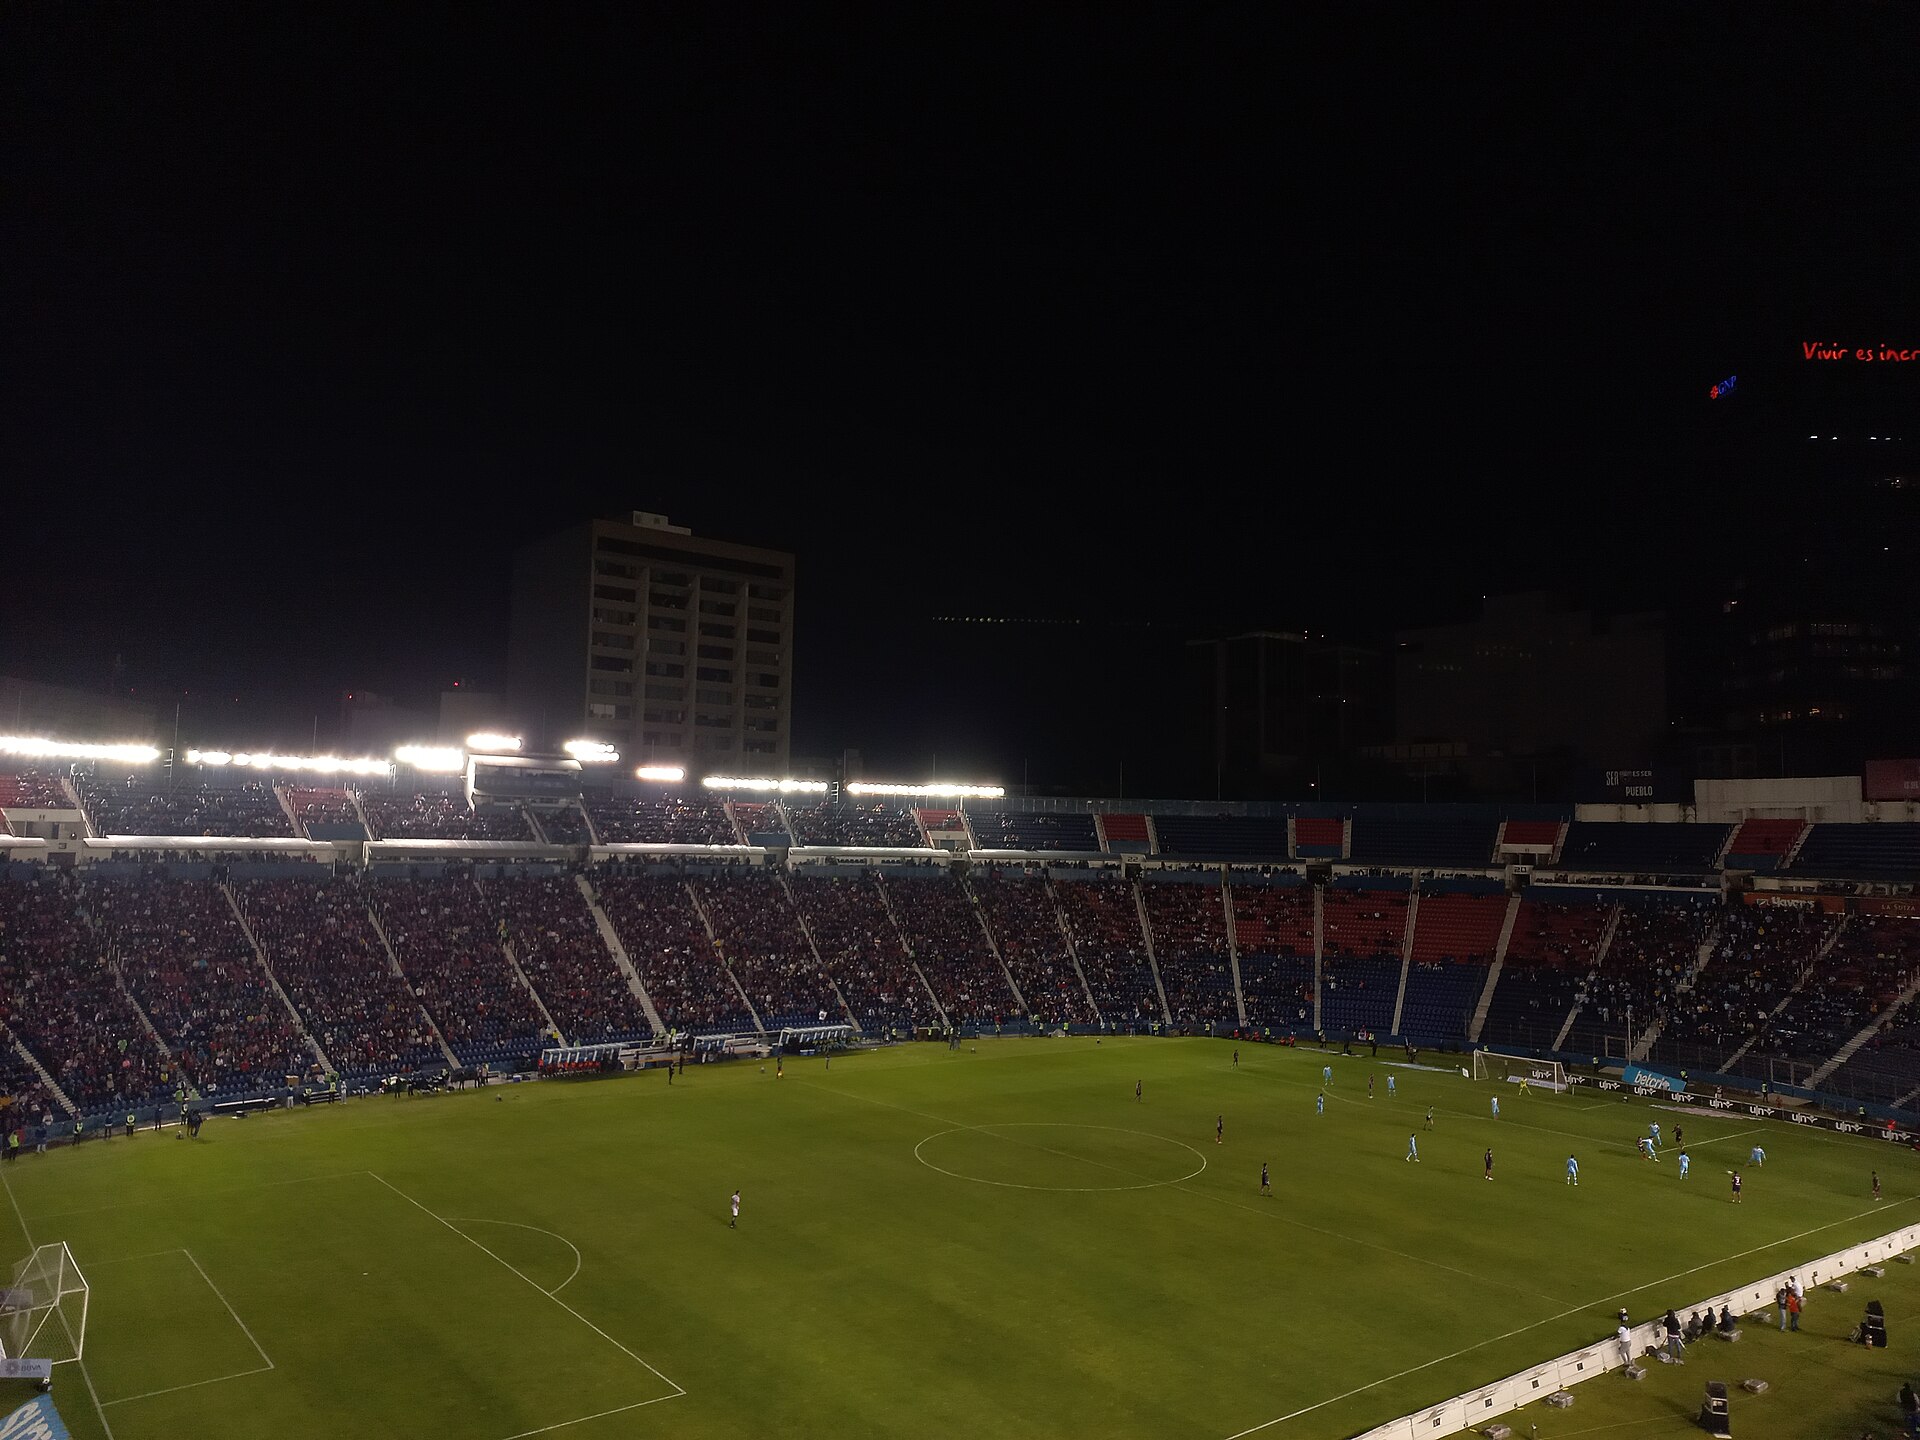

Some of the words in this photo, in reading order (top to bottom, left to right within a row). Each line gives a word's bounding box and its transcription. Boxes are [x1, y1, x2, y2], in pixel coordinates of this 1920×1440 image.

[1802, 341, 1848, 361] Vivir
[1856, 348, 1874, 362] es
[1625, 785, 1653, 797] PUEBLO
